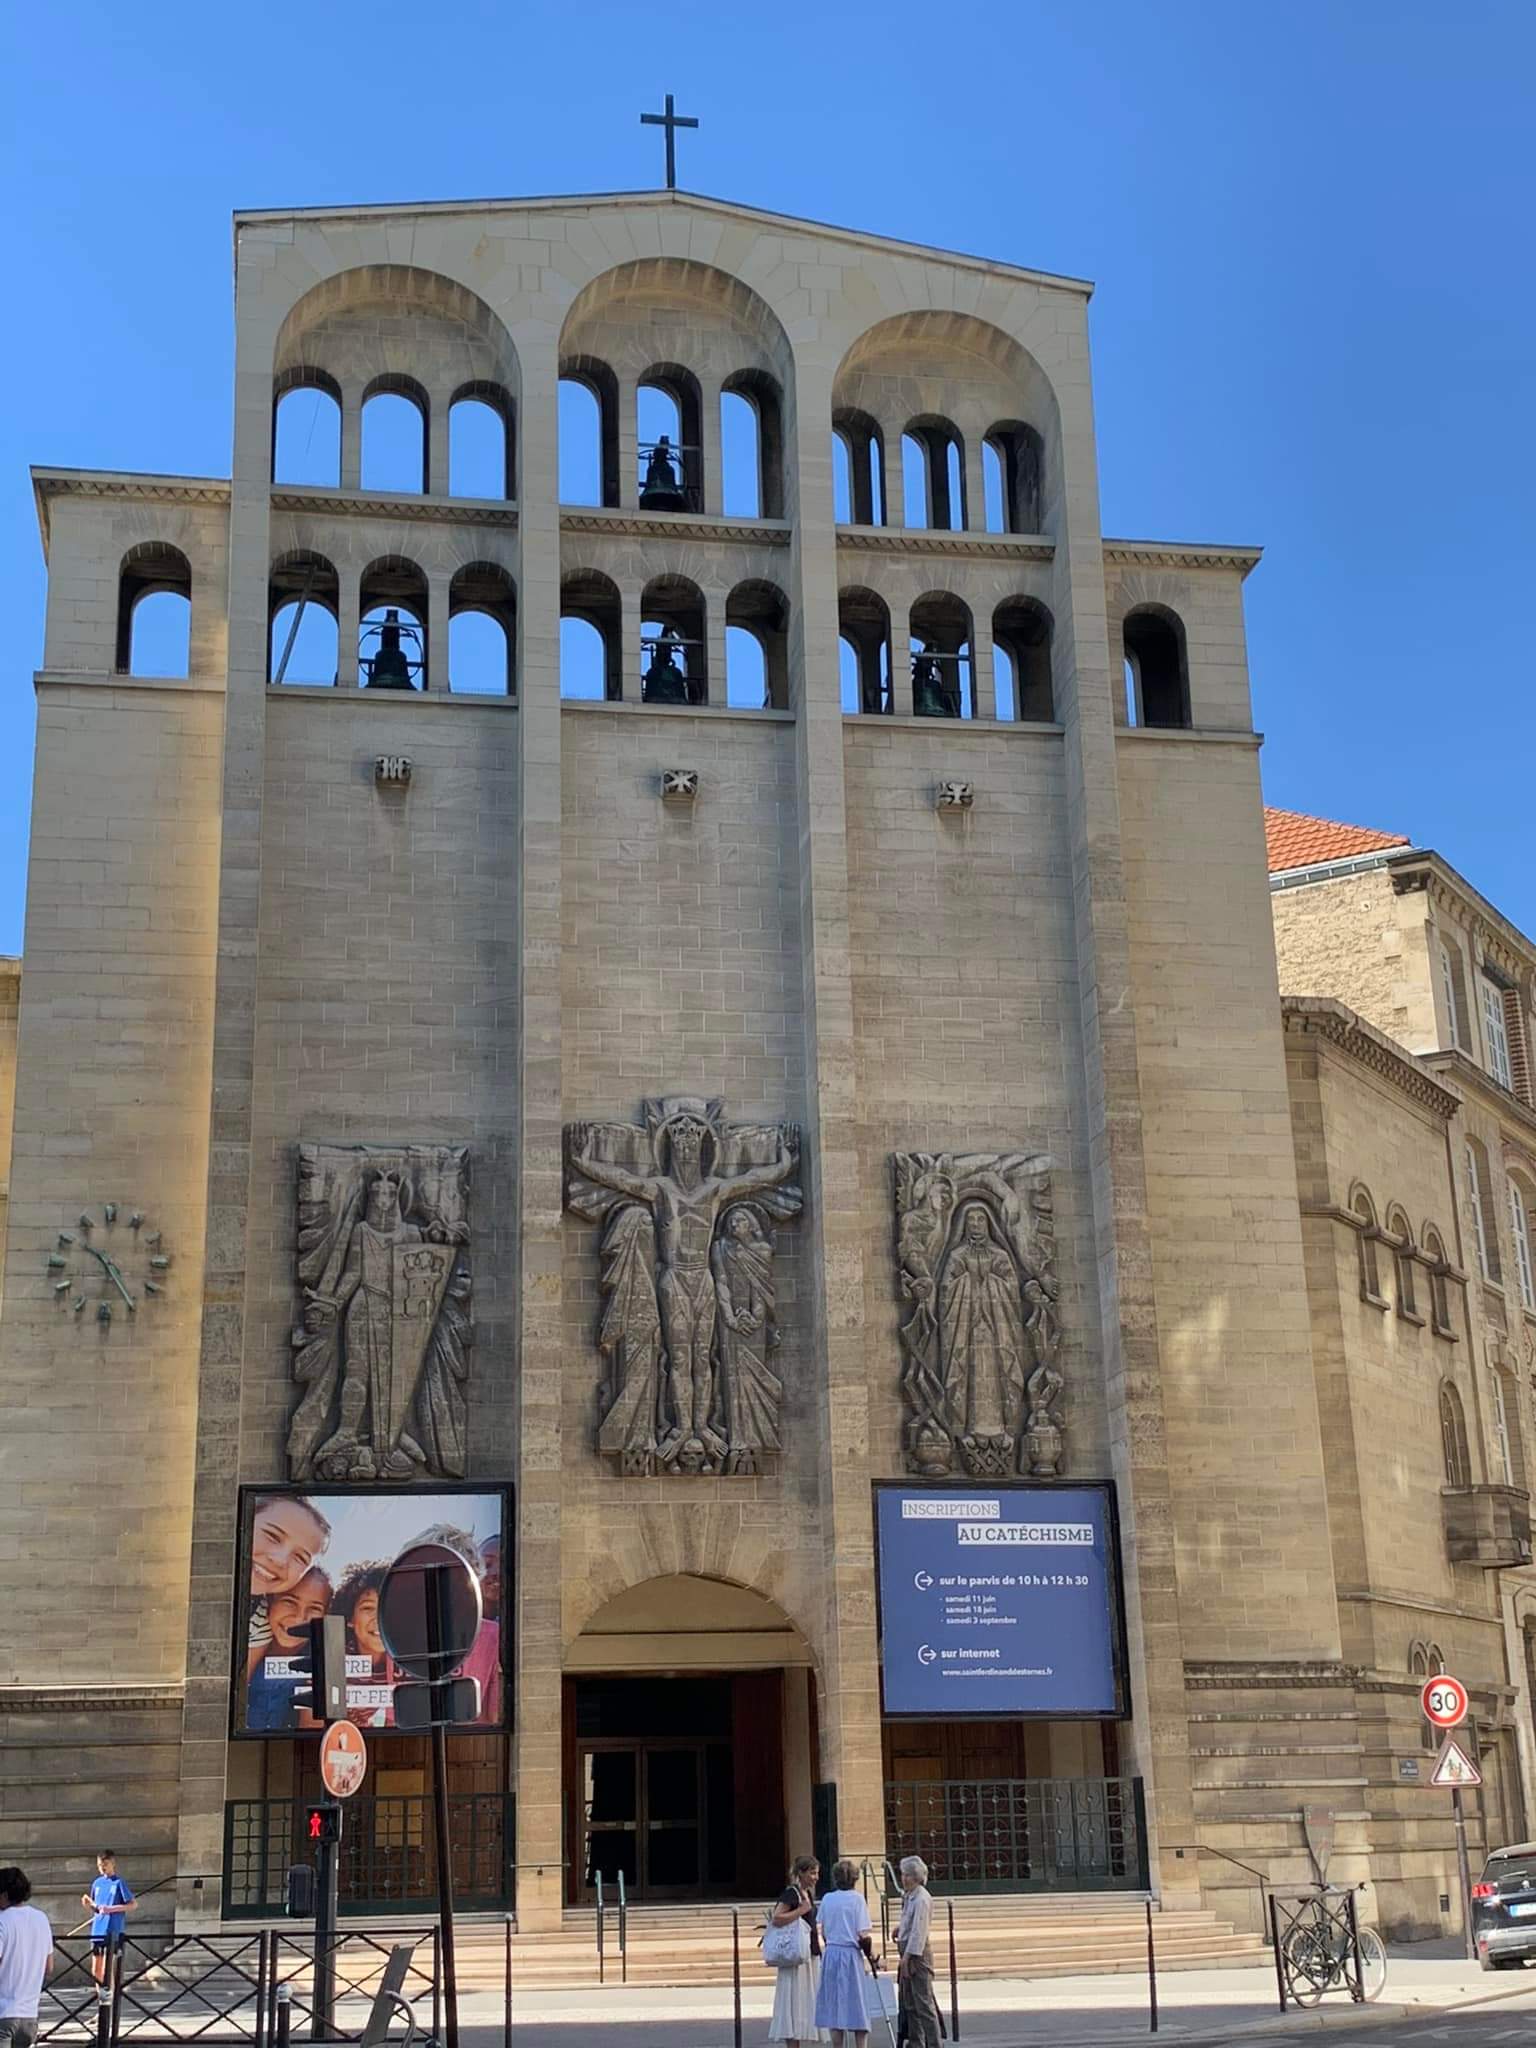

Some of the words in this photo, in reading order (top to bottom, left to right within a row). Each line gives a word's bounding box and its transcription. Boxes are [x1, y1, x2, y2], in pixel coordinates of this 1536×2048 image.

[903, 1503, 999, 1516] INSCRIPTIONS
[958, 1528, 982, 1541] AU
[985, 1525, 1093, 1542] CATÉCHISME
[940, 1577, 956, 1585] sur
[957, 1576, 967, 1585] le
[969, 1575, 1000, 1588] parvis
[1002, 1576, 1016, 1585] de
[1018, 1576, 1032, 1585] 10
[1033, 1576, 1040, 1585] h
[1042, 1575, 1049, 1585] à
[1051, 1576, 1064, 1585] 12
[1066, 1576, 1073, 1585] h
[1075, 1576, 1089, 1585] 30
[945, 1595, 971, 1603] samedi
[972, 1595, 981, 1603] 11
[982, 1595, 996, 1604] juin
[946, 1606, 972, 1614] samedi
[983, 1606, 997, 1615] juin
[946, 1616, 972, 1625] samedi
[980, 1616, 1017, 1626] septembre
[941, 1650, 957, 1659] sur
[959, 1648, 1000, 1659] internet
[1432, 1691, 1458, 1712] 30
